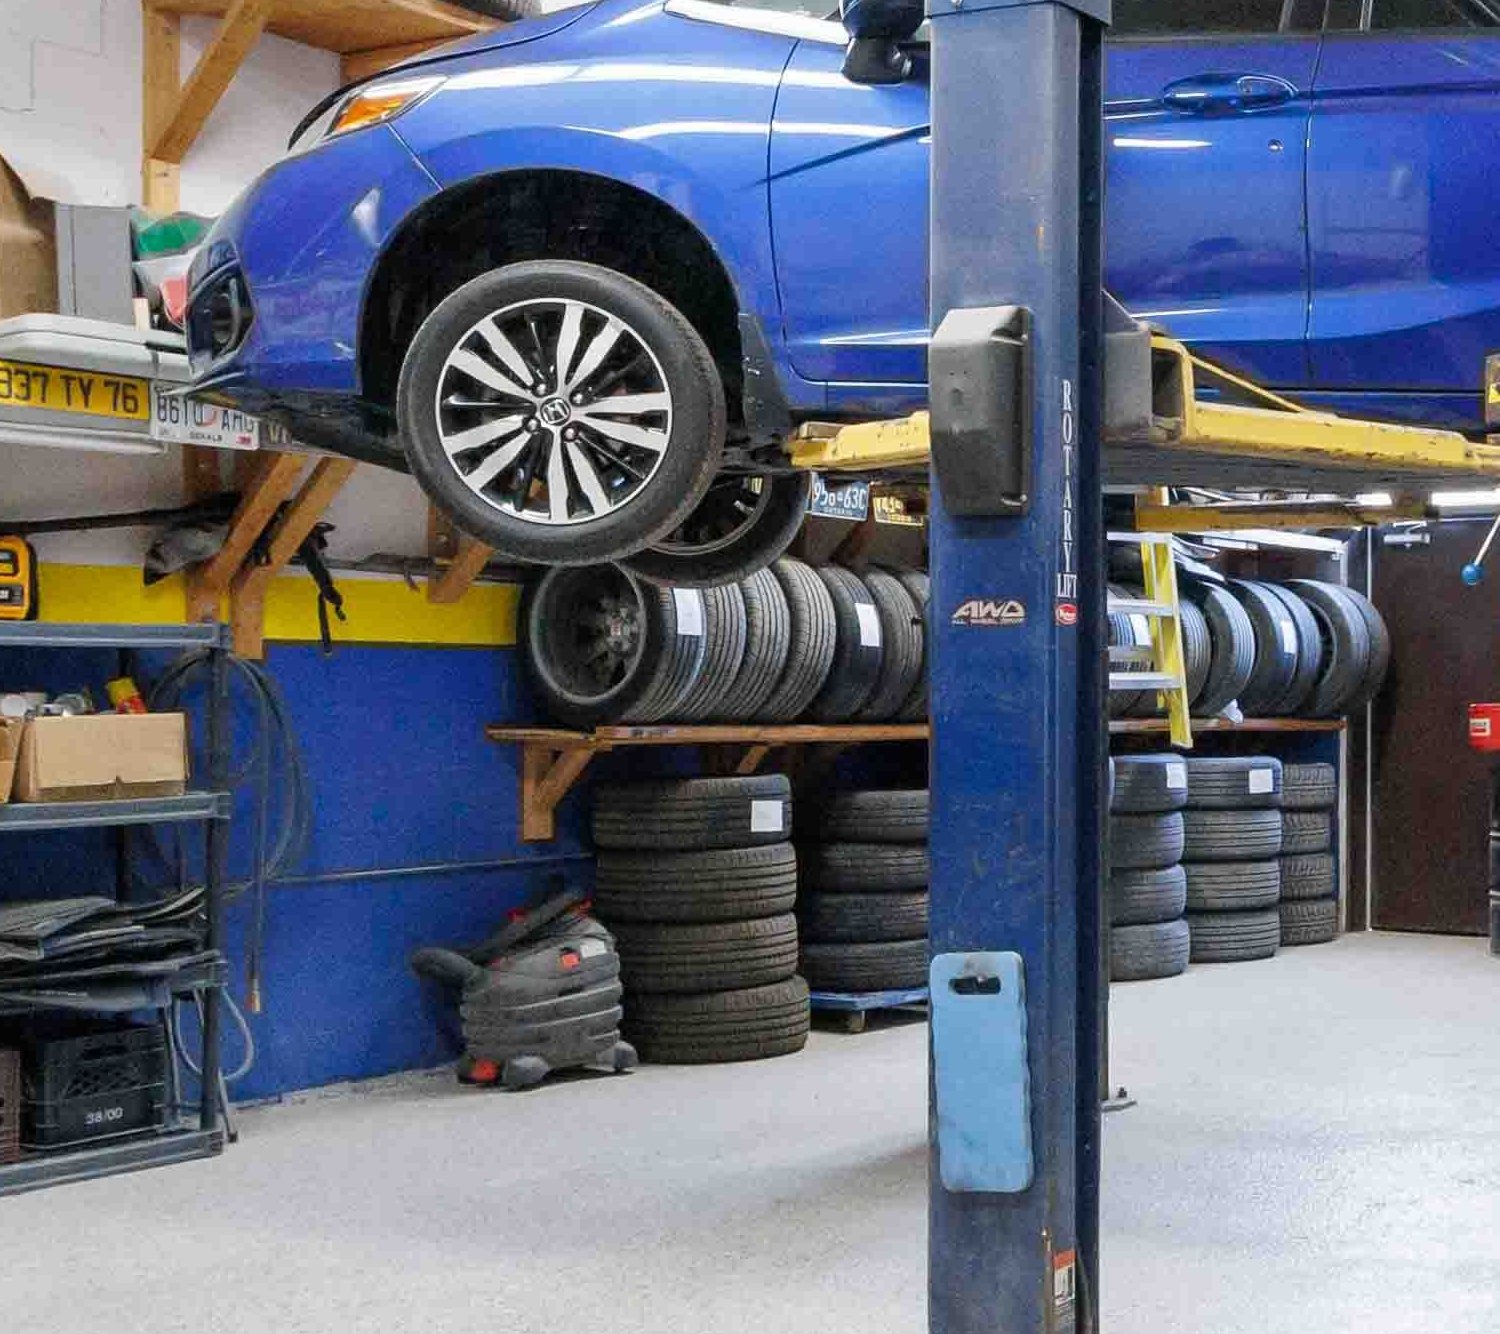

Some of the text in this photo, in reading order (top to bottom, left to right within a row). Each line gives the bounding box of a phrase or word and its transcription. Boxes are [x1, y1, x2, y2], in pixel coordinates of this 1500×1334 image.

[60, 376, 94, 408] TY
[103, 380, 138, 414] 76
[1062, 379, 1073, 572] ROTARY
[1057, 573, 1077, 598] LIFT
[952, 601, 1025, 618] AWD
